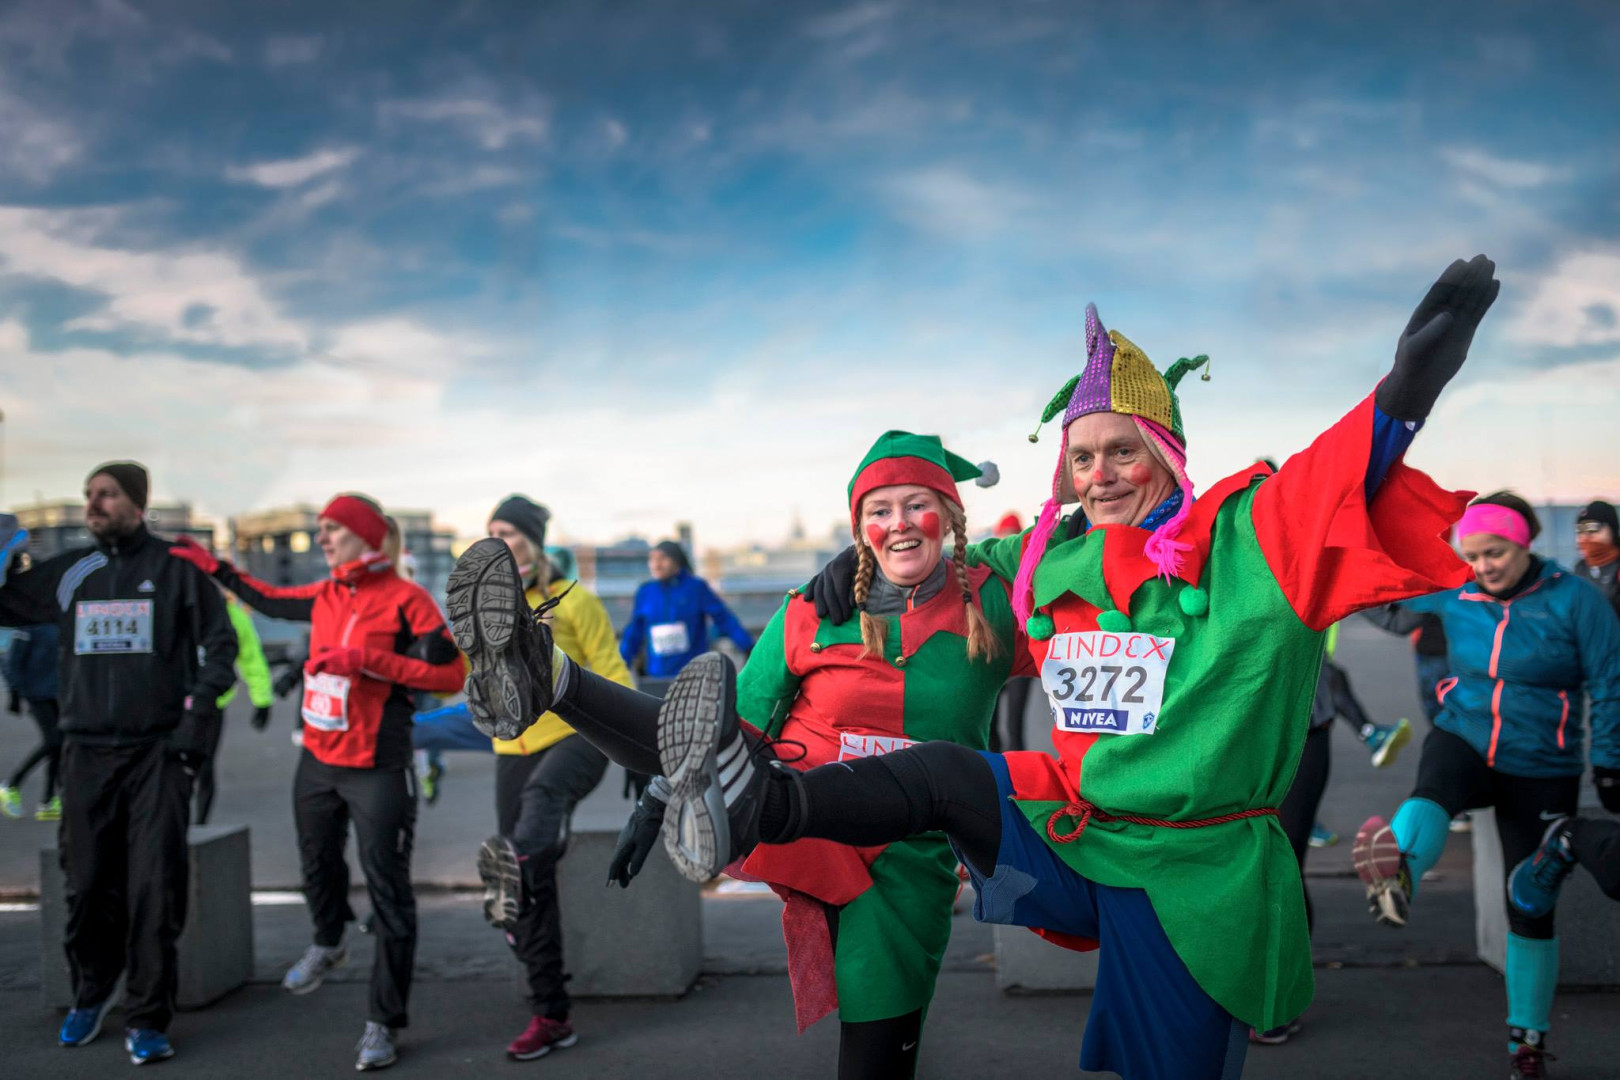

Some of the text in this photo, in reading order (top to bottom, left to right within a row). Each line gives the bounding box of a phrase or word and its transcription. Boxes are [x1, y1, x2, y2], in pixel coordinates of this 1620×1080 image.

[87, 620, 137, 635] 4114
[1048, 634, 1170, 660] LINDEX
[1052, 665, 1148, 704] 3272
[1070, 711, 1118, 727] NIVEA
